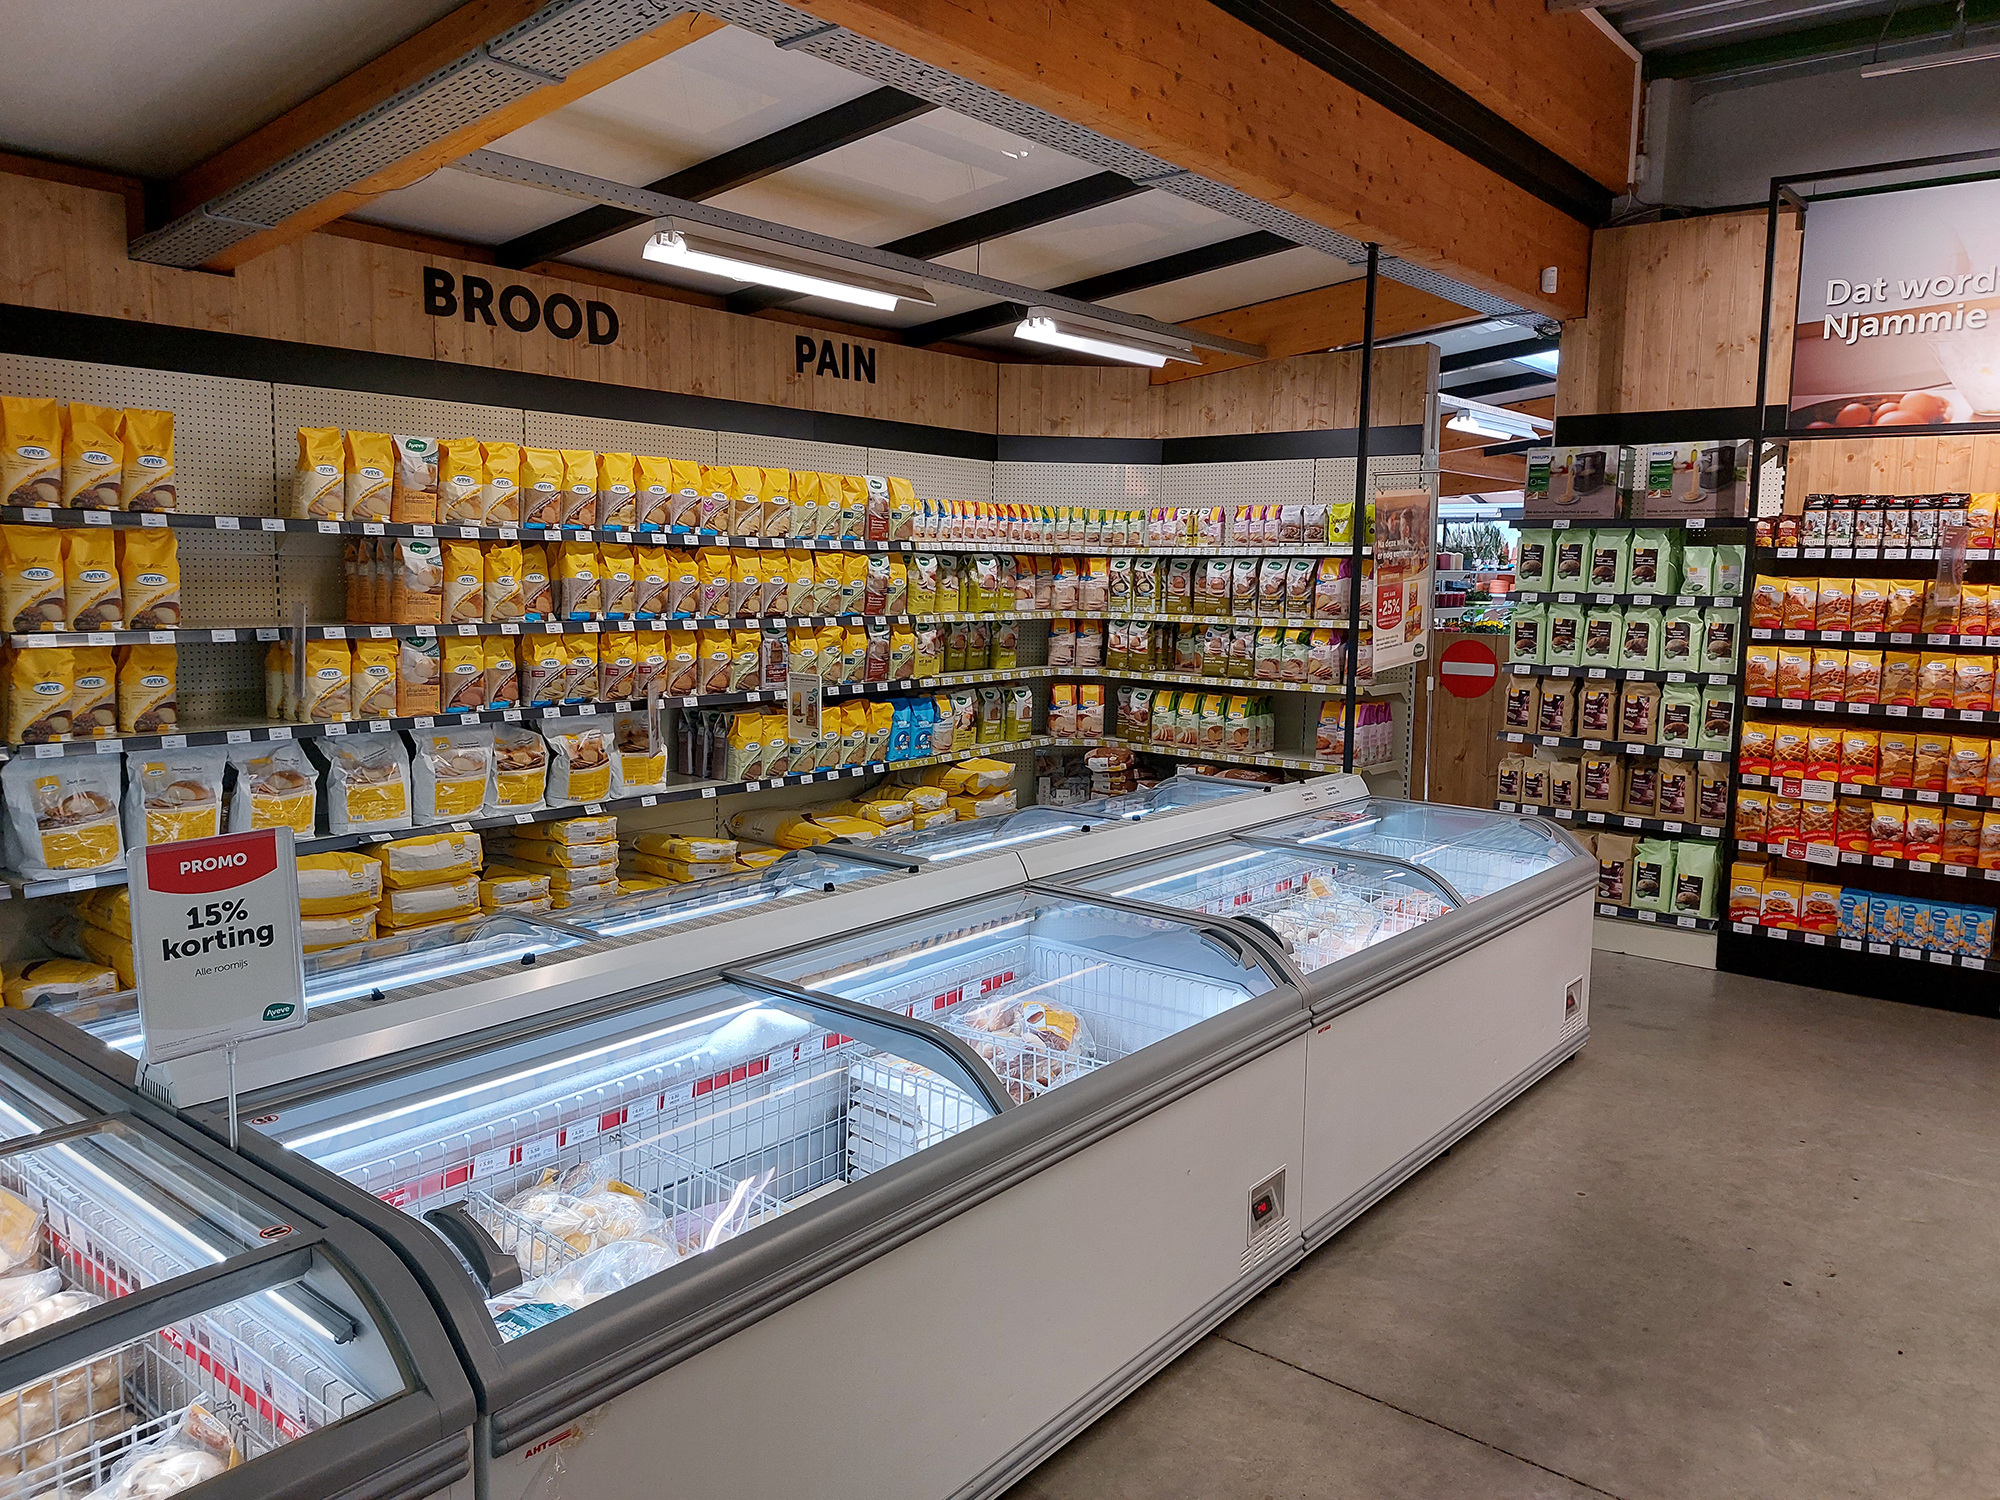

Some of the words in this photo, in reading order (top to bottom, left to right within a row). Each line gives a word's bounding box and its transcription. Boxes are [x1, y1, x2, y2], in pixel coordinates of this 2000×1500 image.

[1826, 277, 1888, 306] Dat
[1897, 265, 2000, 300] word
[422, 266, 619, 346] BROOD
[1823, 303, 1988, 345] Njammie
[795, 334, 876, 384] PAIN
[23, 446, 46, 457] AVEVE
[87, 454, 109, 463] AVEVE
[143, 458, 163, 466] AVEVE
[27, 570, 49, 578] AVEVE
[85, 571, 107, 580] AVEVE
[142, 576, 163, 584] AVEVE
[1378, 598, 1401, 616] -25%
[80, 678, 101, 687] AVEVE
[145, 677, 165, 685] AVEVE
[39, 684, 60, 692] AVEVE
[1783, 786, 1800, 794] -25%
[1788, 848, 1805, 856] -25%
[179, 852, 248, 876] PROMO
[186, 898, 249, 931] 15%
[161, 923, 275, 962] korting
[195, 966, 213, 977] Alle
[214, 959, 249, 975] roomijs
[266, 1005, 291, 1018] Aveve
[524, 1439, 549, 1460] AHT
